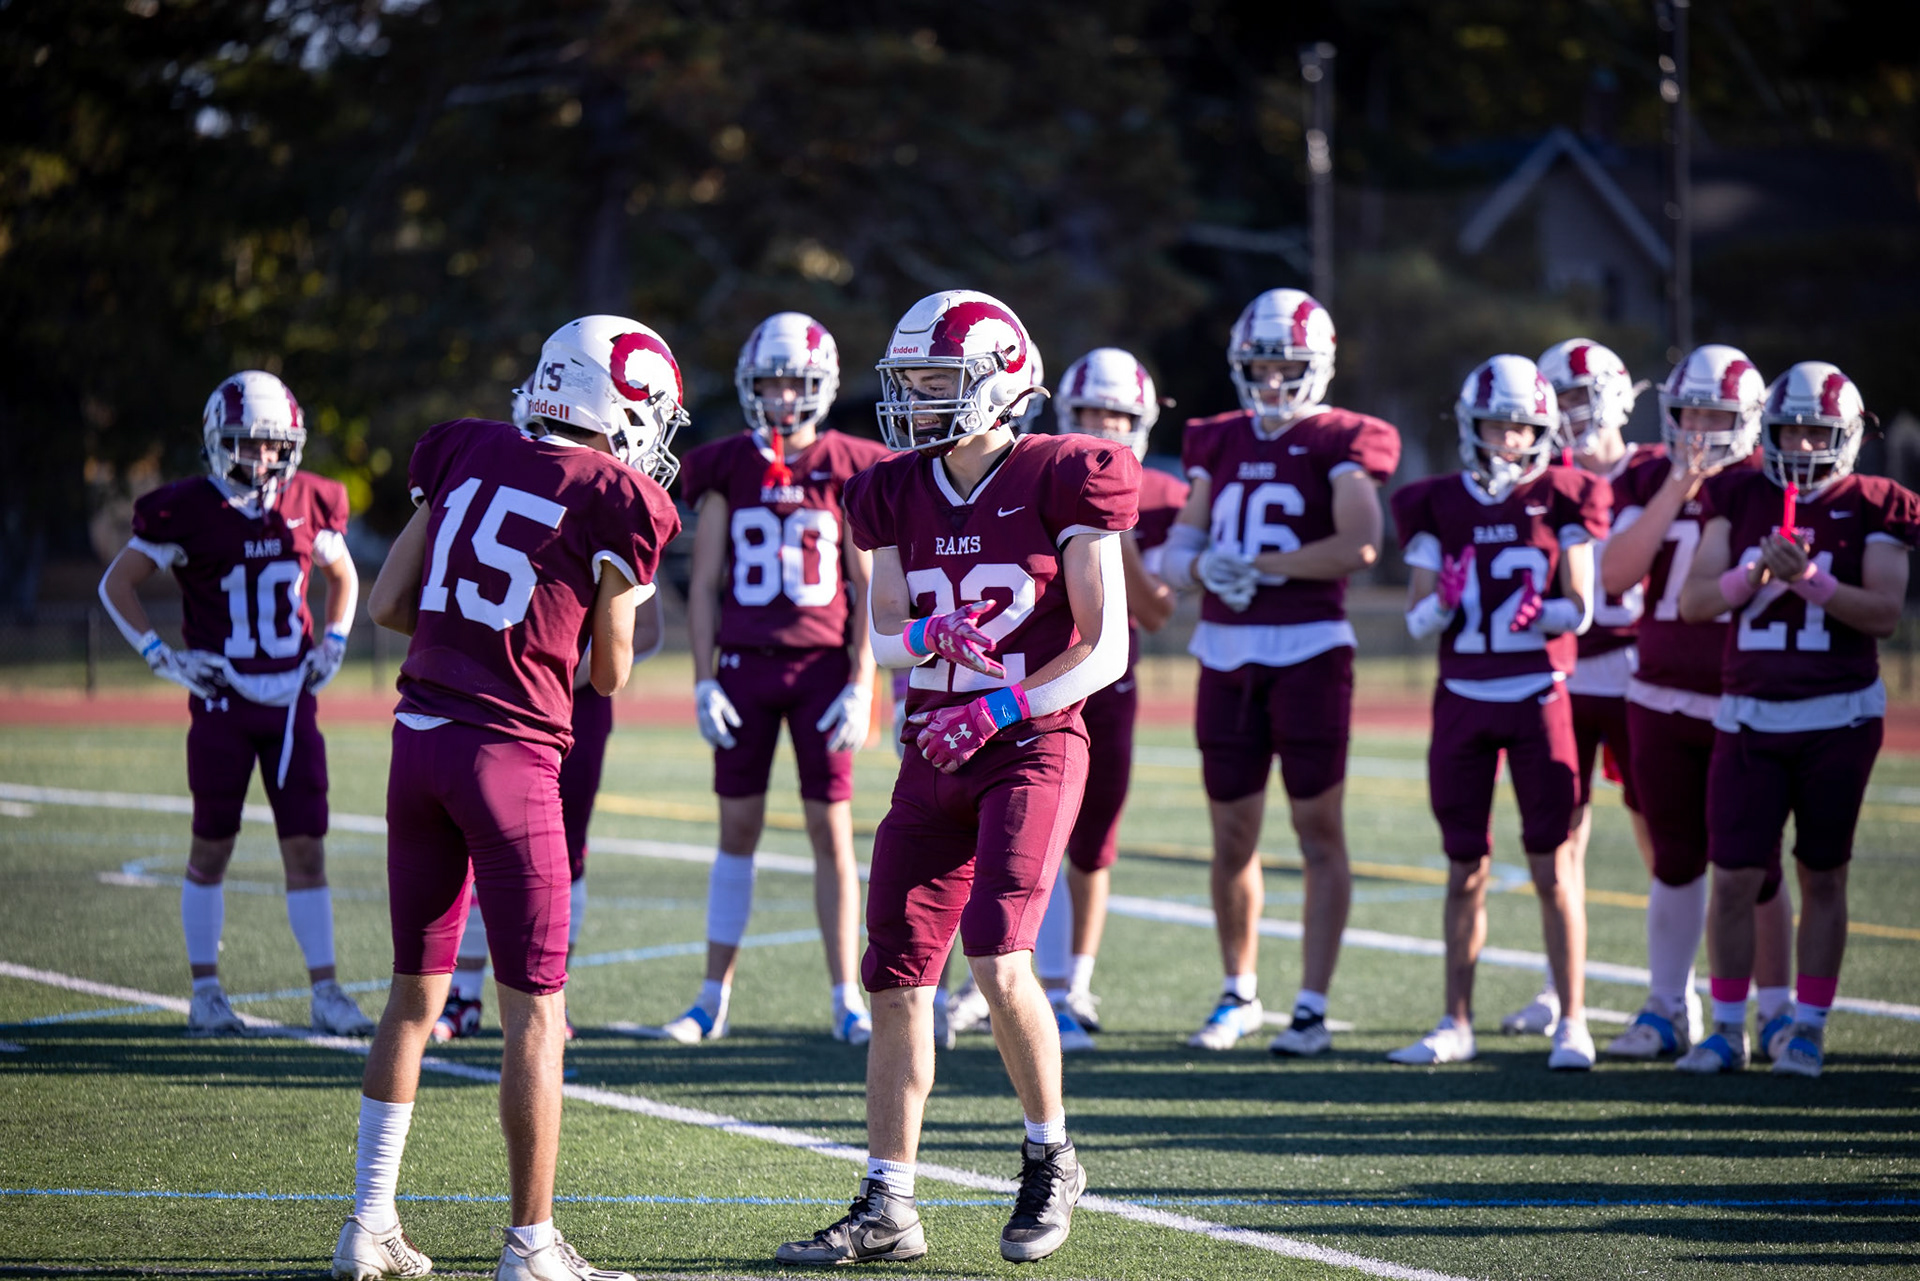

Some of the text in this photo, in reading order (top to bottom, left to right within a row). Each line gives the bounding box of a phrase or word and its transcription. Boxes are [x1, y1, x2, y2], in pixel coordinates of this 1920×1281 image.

[539, 361, 565, 392] 15
[244, 539, 282, 558] RAMS
[420, 477, 567, 632] 15
[731, 506, 839, 607] 80
[935, 535, 981, 556] RAMS
[1210, 482, 1305, 586] 46
[220, 560, 304, 659] 10
[906, 563, 1036, 693] 22
[1454, 546, 1549, 653] 12
[1737, 546, 1833, 651] 21
